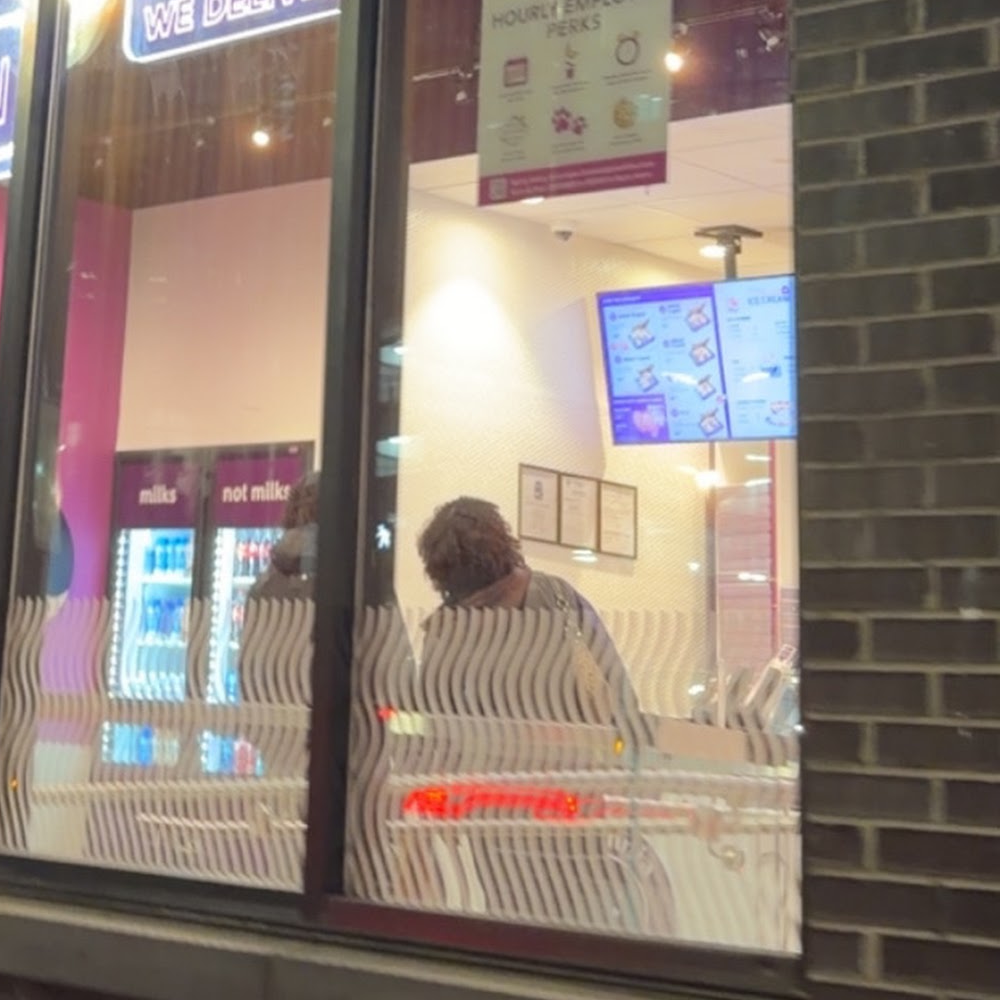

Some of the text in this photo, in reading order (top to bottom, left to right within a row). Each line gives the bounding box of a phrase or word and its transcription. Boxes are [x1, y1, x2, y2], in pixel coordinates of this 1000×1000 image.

[492, 0, 559, 29] HOURLY
[547, 13, 601, 38] PERKS
[139, 484, 177, 505] milks
[222, 480, 291, 503] not milks
